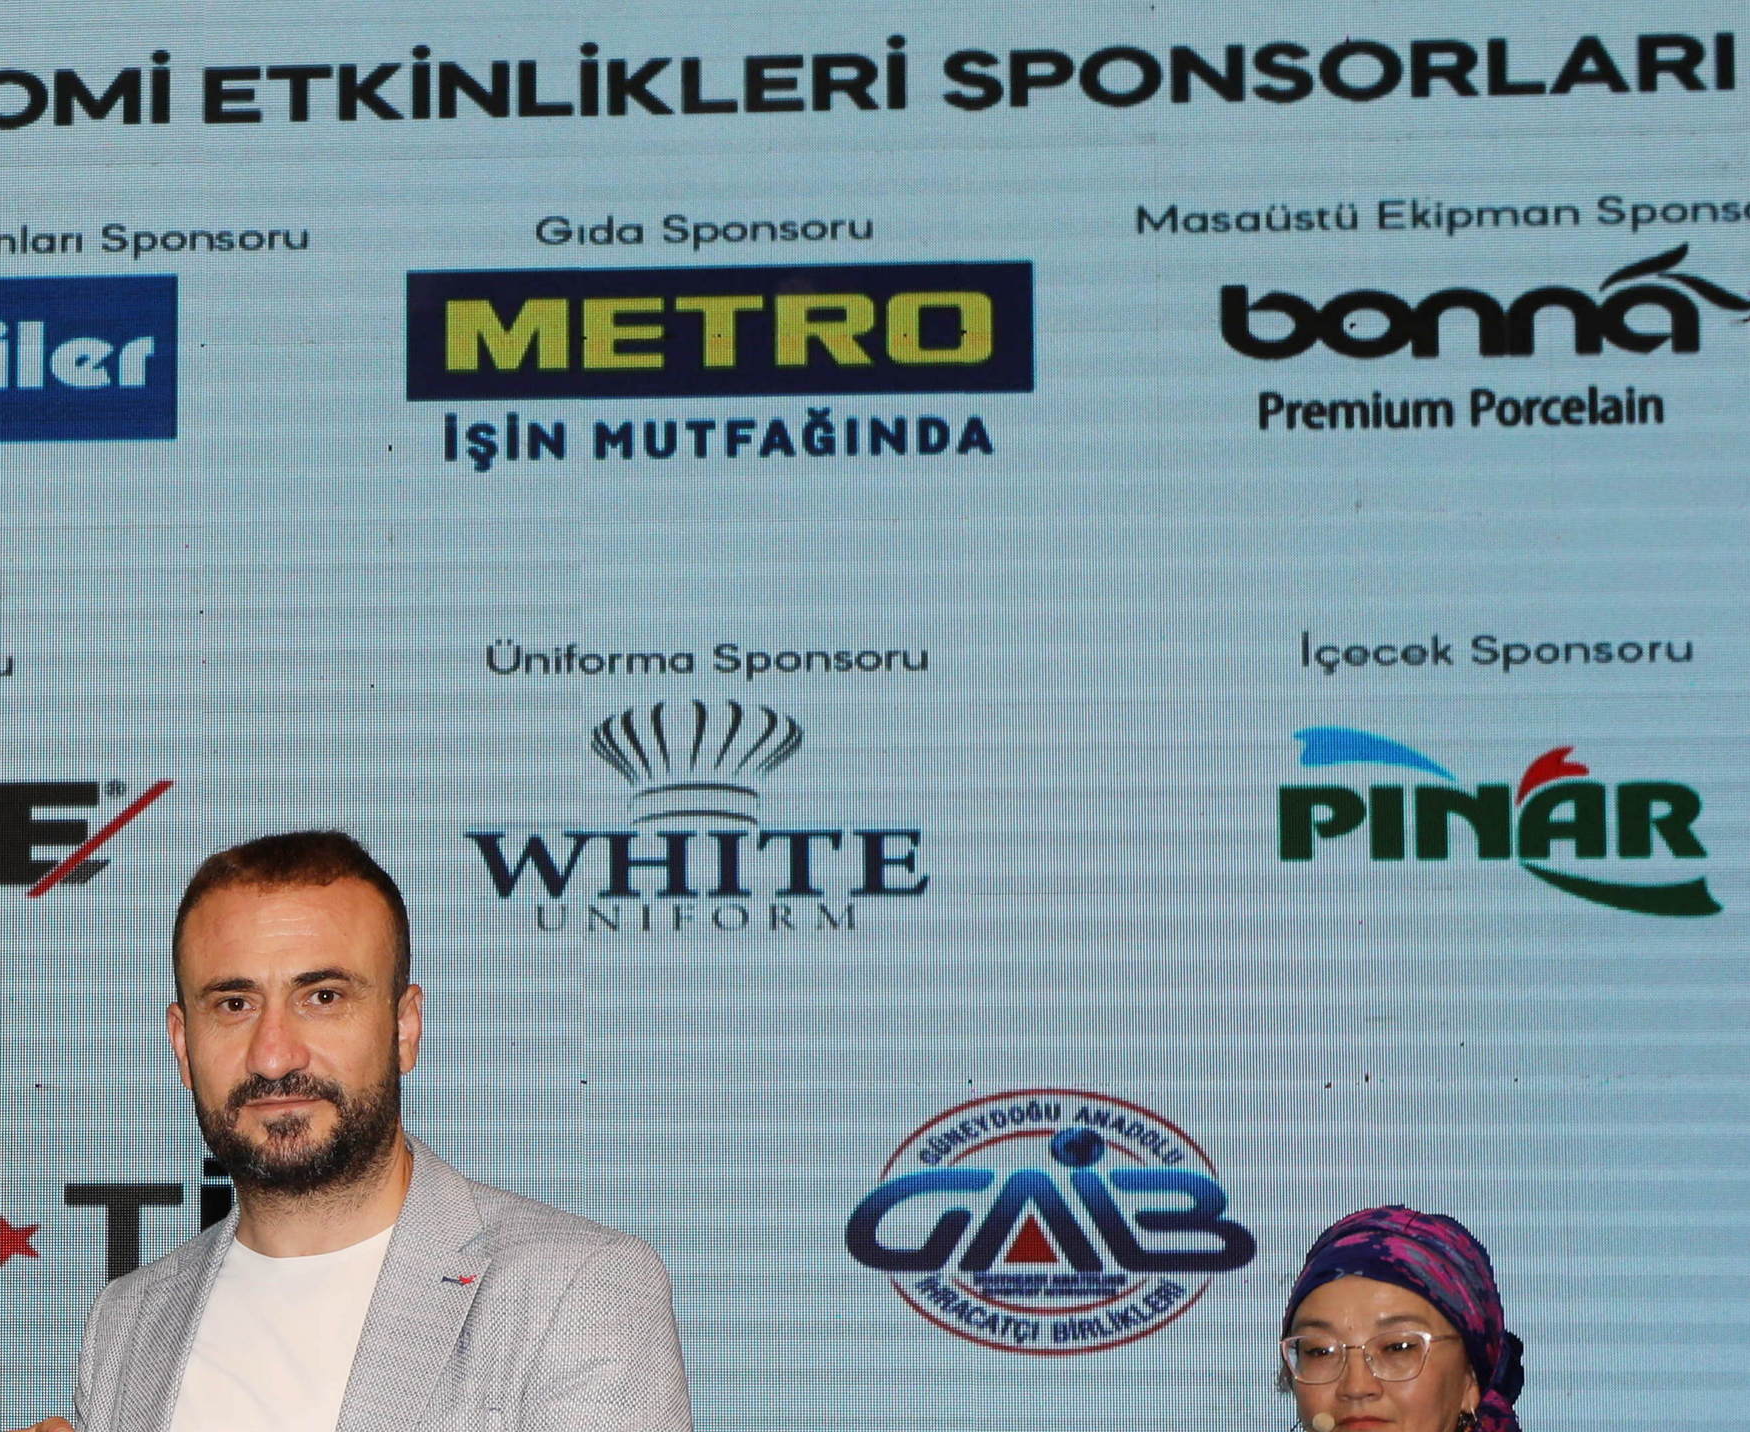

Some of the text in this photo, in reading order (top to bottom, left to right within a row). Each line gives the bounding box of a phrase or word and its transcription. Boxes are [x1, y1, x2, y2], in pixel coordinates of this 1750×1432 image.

[203, 35, 907, 125] ETKİNLİKLERİ
[943, 32, 1736, 112] SPONSORLARI
[534, 214, 874, 252] Gıda Sponsoru
[1135, 195, 1750, 237] Masaüstü Ekipman Spons
[101, 223, 310, 260] Sponsoru
[446, 291, 994, 370] METRO
[1258, 385, 1665, 431] Premium Porcelain
[594, 408, 993, 461] MUTFAĞINDA
[485, 643, 929, 682] Üniforma Sponsoru
[1301, 630, 1694, 672] İçecek Sponsoru
[1278, 781, 1707, 861] PINAR
[466, 830, 928, 899] WHITE
[535, 903, 856, 933] UNIFORM
[919, 1101, 1185, 1166] GÜNEYDOĞU ANADOLU
